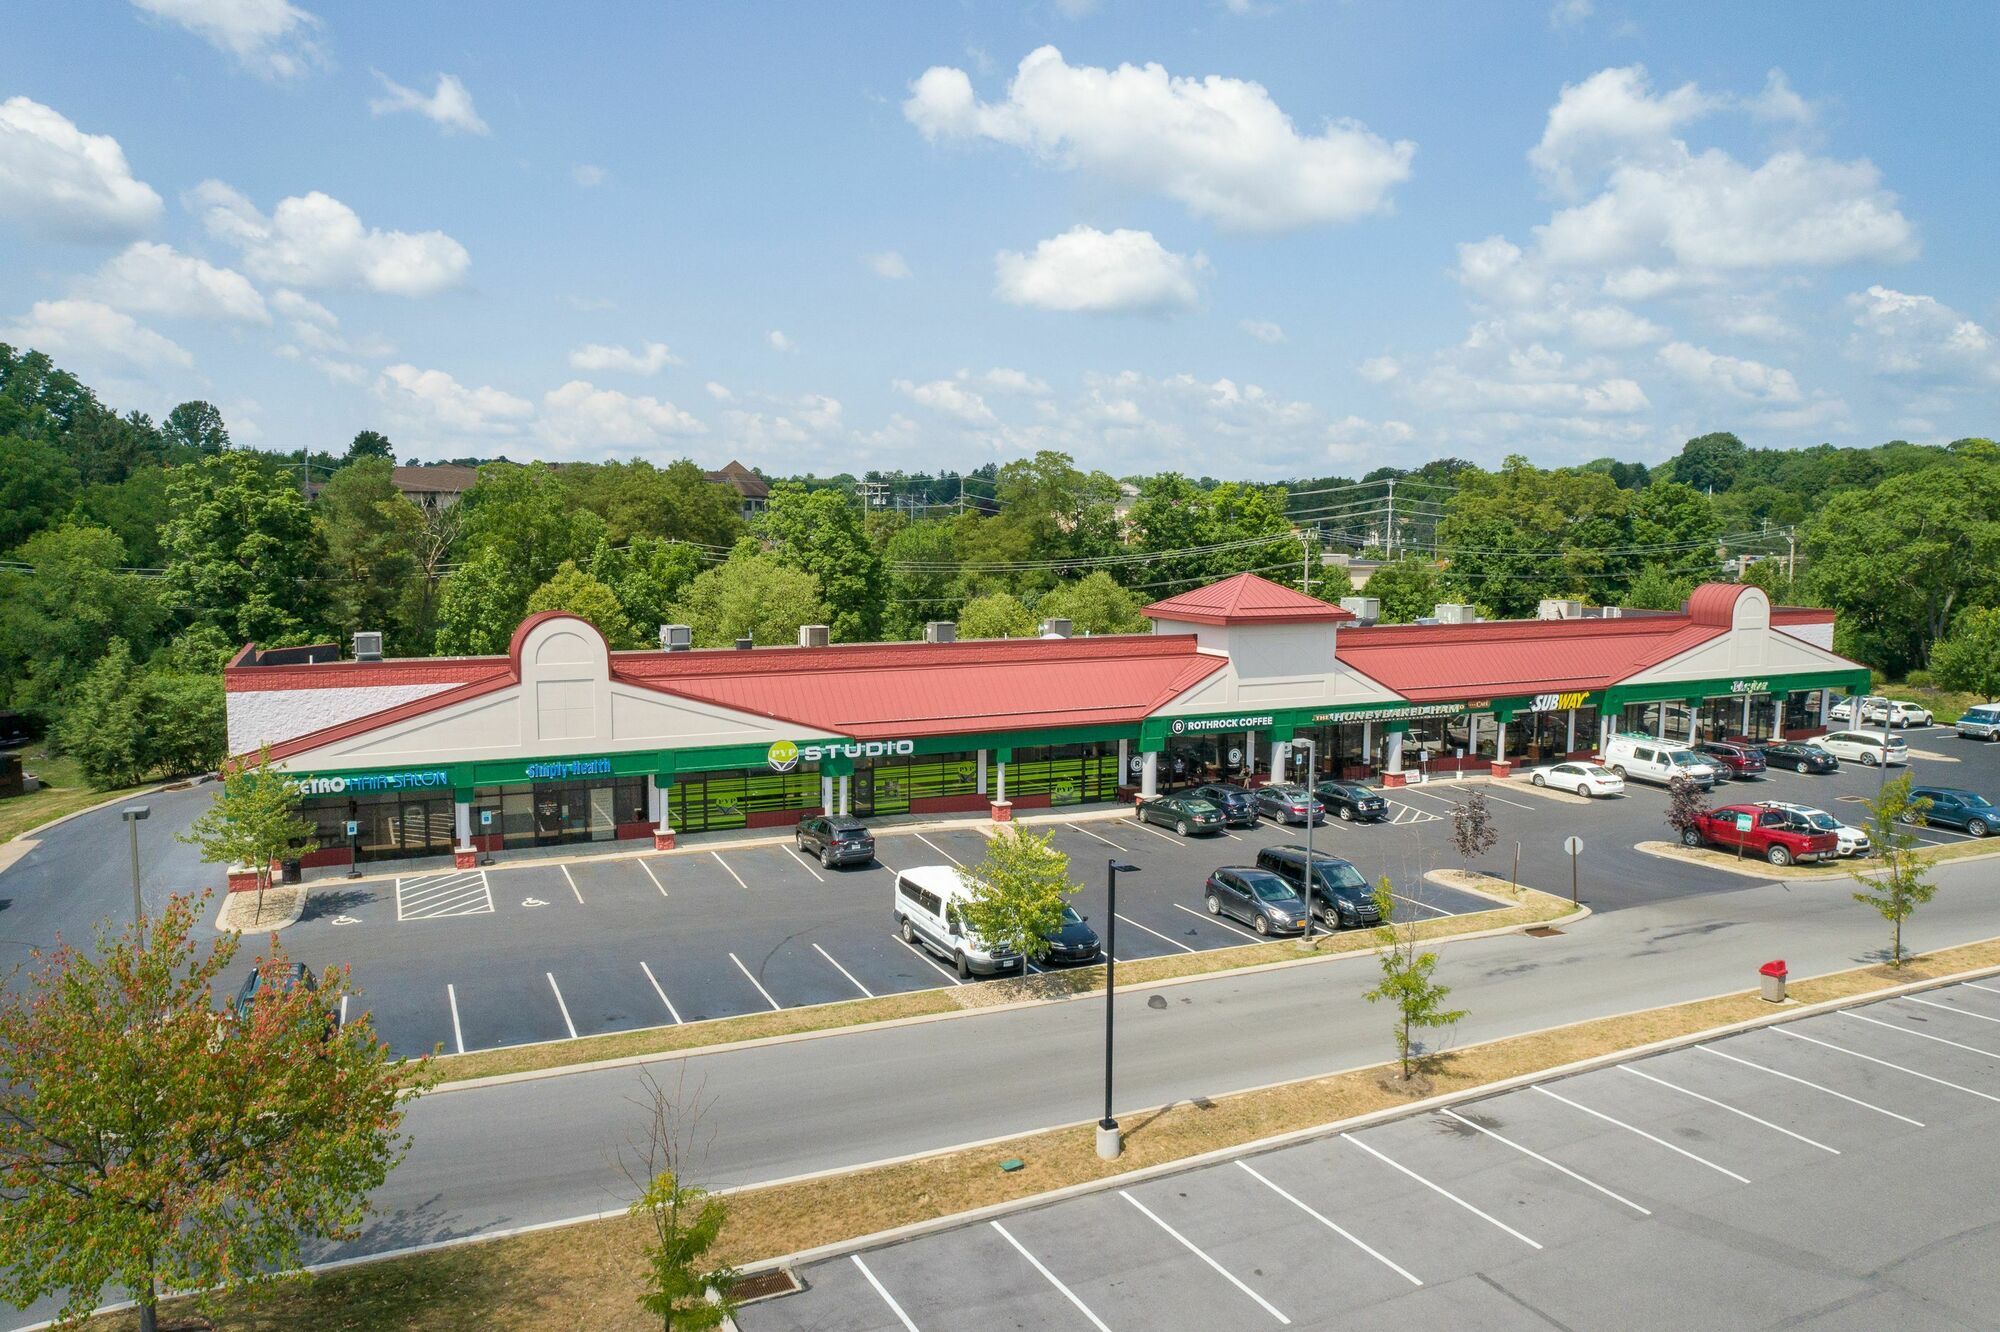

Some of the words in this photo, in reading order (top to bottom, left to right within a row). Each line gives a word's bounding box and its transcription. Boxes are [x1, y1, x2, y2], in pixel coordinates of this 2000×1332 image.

[1430, 703, 1460, 714] HAM
[1530, 691, 1590, 712] SUBWAY
[1187, 718, 1239, 731] ROTHROCK
[1239, 716, 1273, 727] COFFEE
[771, 748, 797, 758] PYP
[804, 739, 914, 761] STUDIO
[527, 761, 568, 779] Simply
[571, 758, 611, 775] Health
[350, 773, 388, 791] HAIR
[392, 770, 448, 789] SALON
